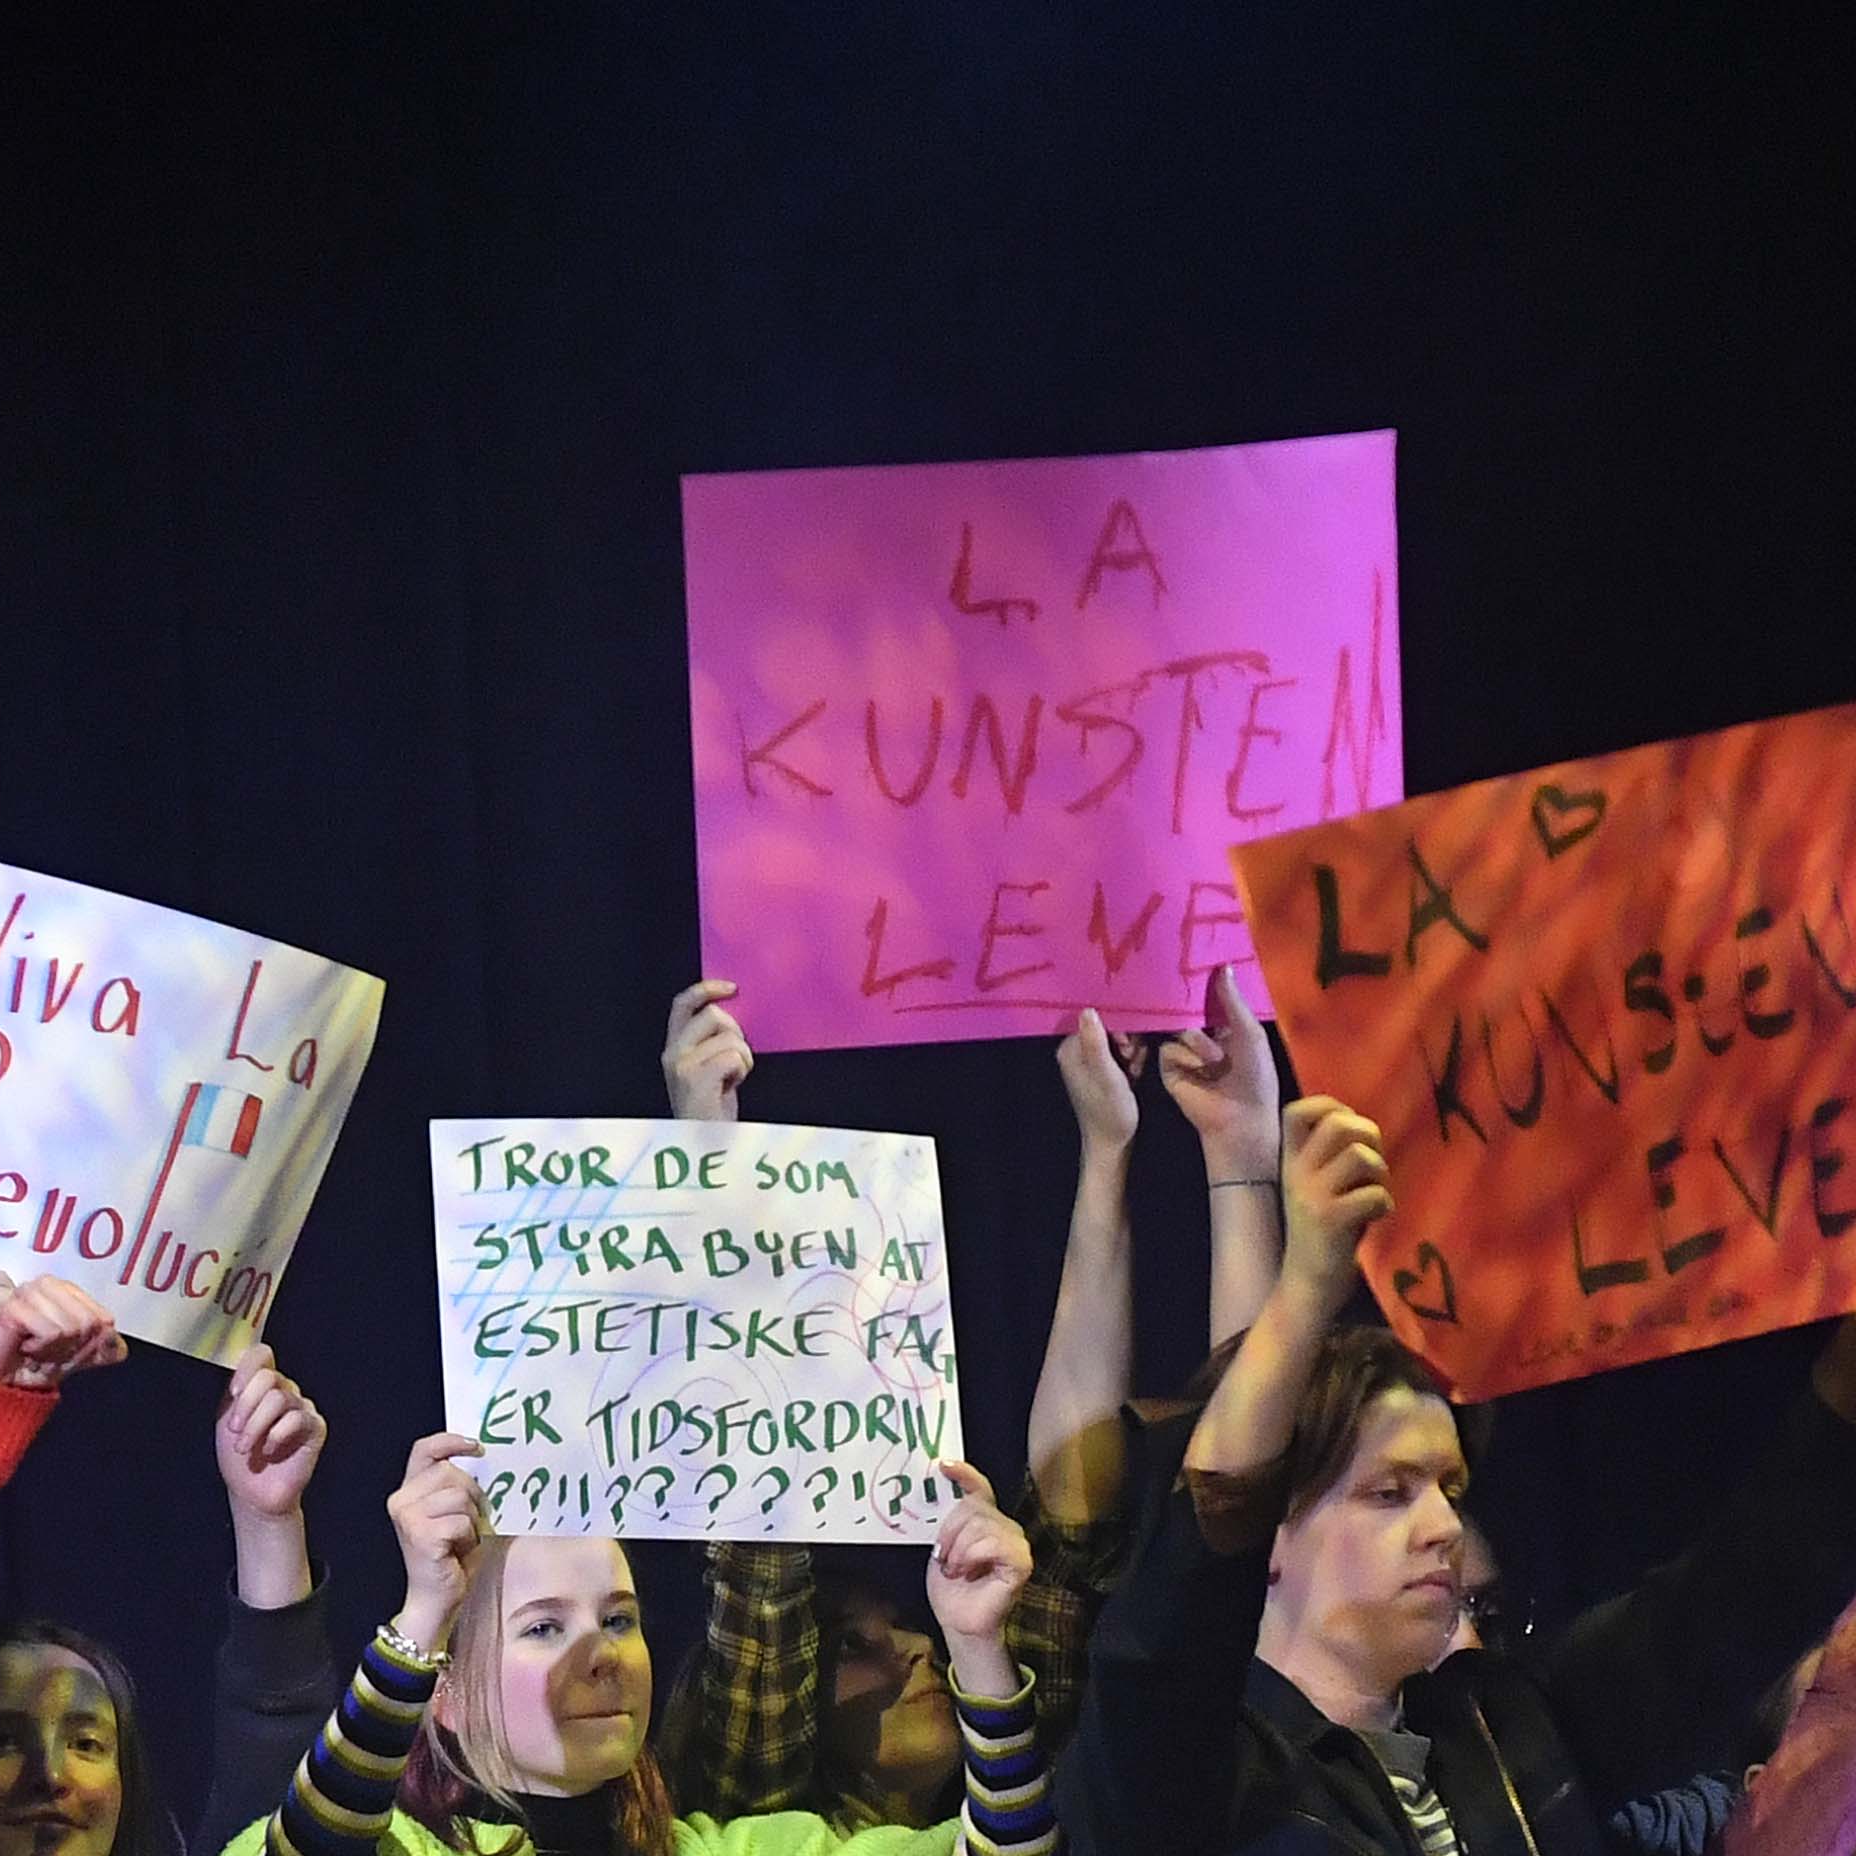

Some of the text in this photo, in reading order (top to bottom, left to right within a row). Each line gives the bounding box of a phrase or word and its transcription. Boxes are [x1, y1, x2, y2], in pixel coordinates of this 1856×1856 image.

[949, 498, 1168, 626] LA
[738, 567, 1387, 836] KUNSTEN
[859, 879, 1255, 998] LEVE
[1314, 836, 1490, 990] LA
[226, 959, 319, 1091] La
[457, 1136, 860, 1200] TROR DE SOM
[702, 1226, 858, 1279] BYEN
[878, 1237, 933, 1281] AT
[472, 1298, 955, 1385] ESTETISKE FAG
[478, 1387, 947, 1469] ER TIDSFORDRIV
